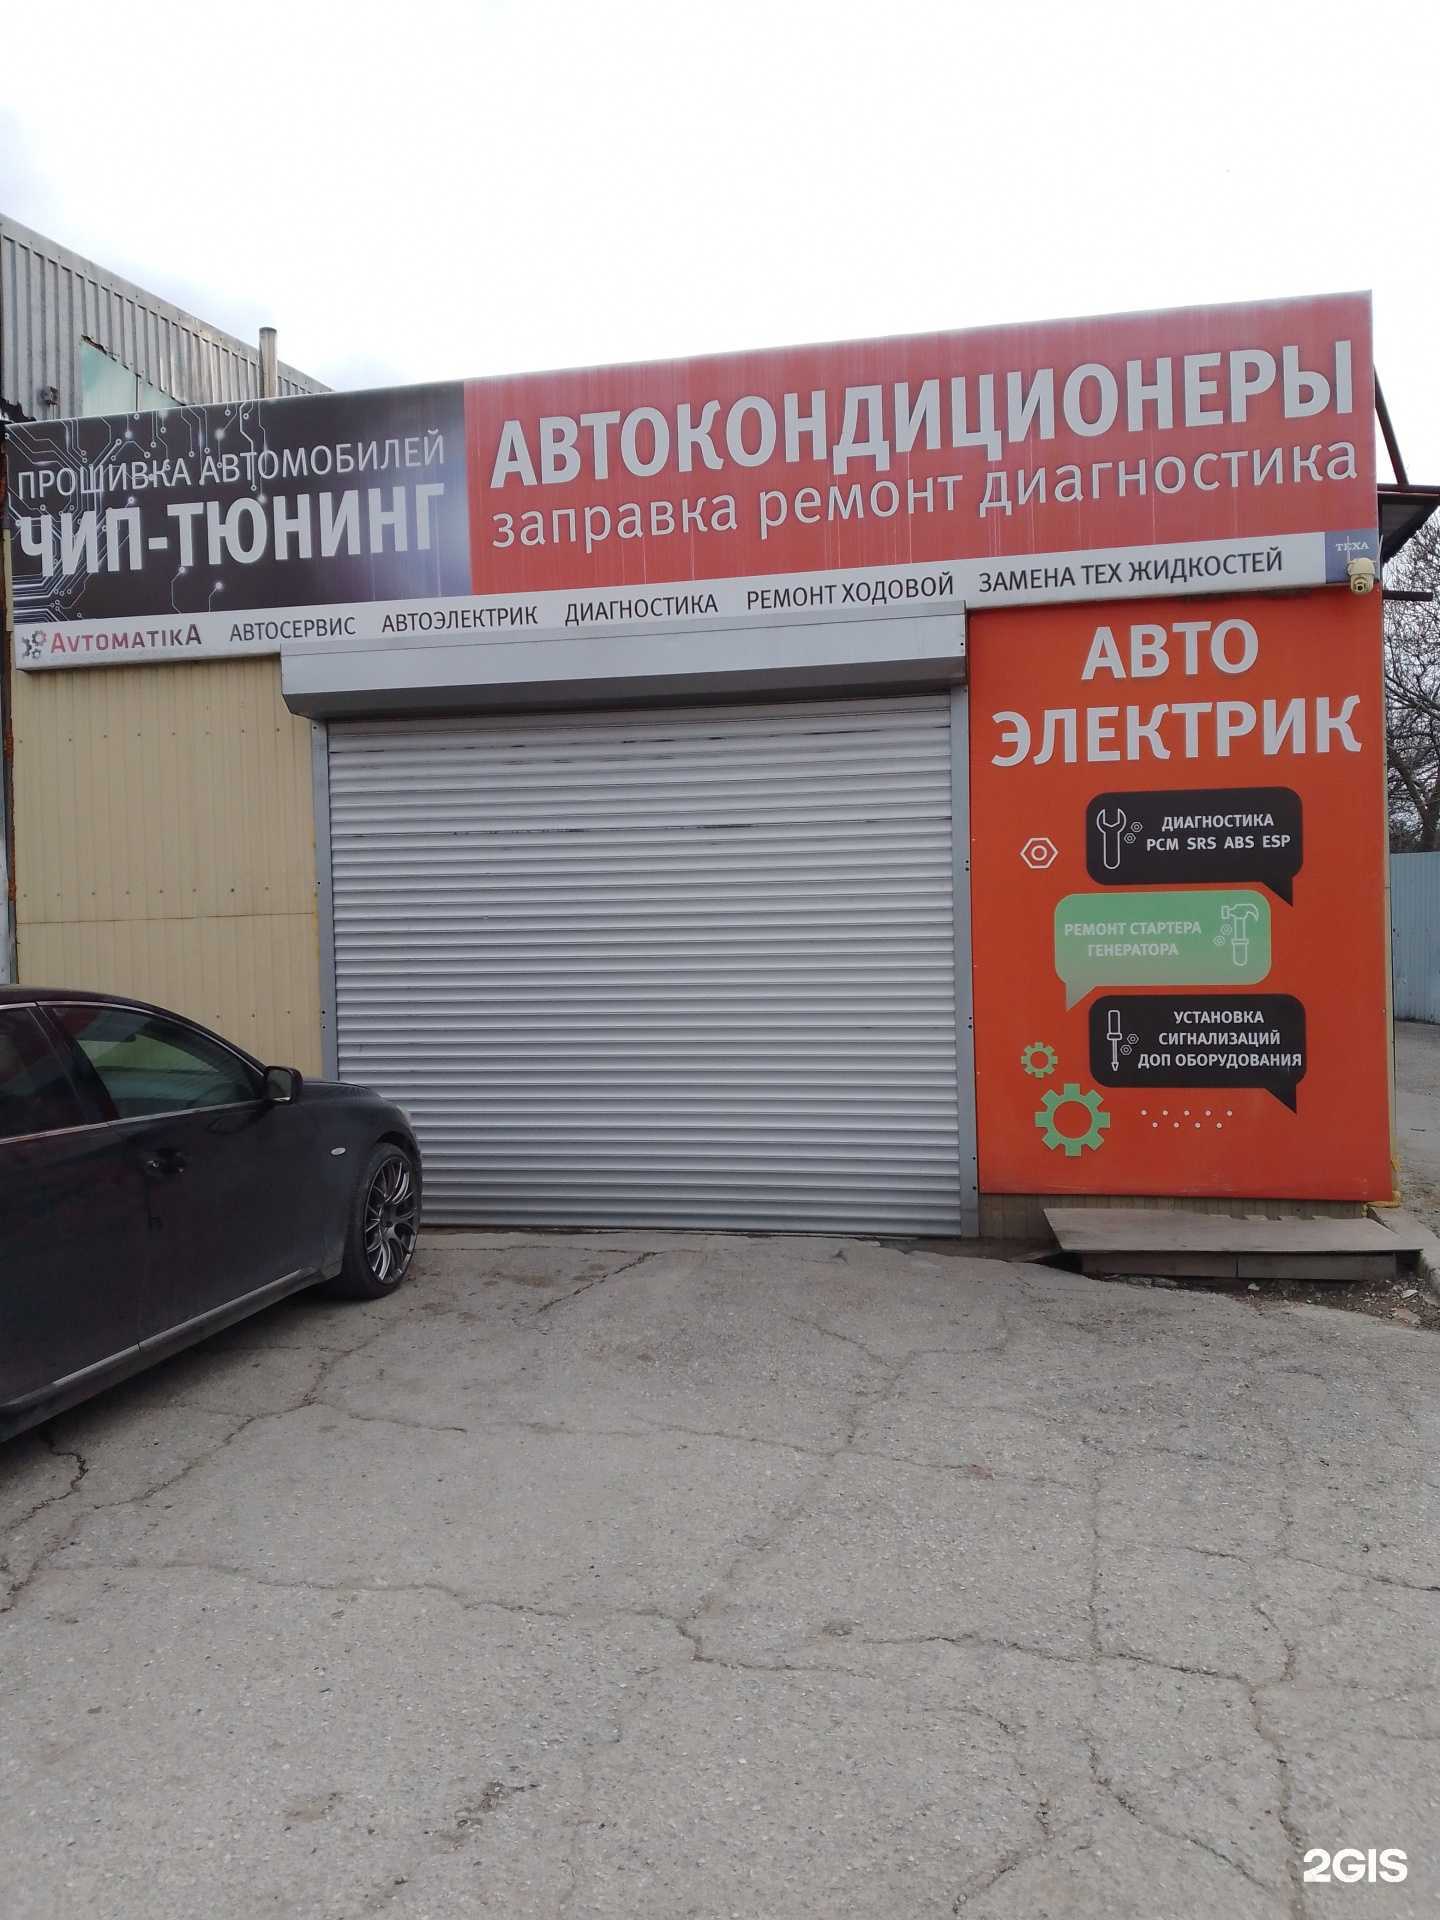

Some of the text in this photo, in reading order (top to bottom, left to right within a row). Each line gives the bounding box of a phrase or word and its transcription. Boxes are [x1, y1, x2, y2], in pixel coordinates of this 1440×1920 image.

[490, 340, 1353, 488] АВТОКОНДИЦИОНЕРЫ
[18, 429, 445, 499] ПРОШИВКА АВТОМОБИЛЕЙ
[492, 441, 1358, 554] заправка ремонт диагностика
[20, 483, 445, 577] ЧИП-ТЮНИНГ
[979, 547, 1283, 593] ЗАМЕНА ТЕХ ЖИДКОСТЕЙ
[747, 572, 954, 610] РЕМОНТ ХОДОВОЙ
[382, 606, 538, 633] АВТОЭЛЕКТРИК
[565, 594, 718, 626] ДИАГНОСТИКА
[230, 617, 356, 642] АВТОСЕРВИС
[1081, 618, 1259, 680] АВТО
[991, 695, 1362, 767] ЭЛЕКТРИК
[1162, 813, 1274, 832] ДИАГНОСТИКА
[1187, 836, 1217, 850] SRS
[1224, 835, 1255, 849] ABS
[1262, 834, 1291, 848] ESP
[1064, 920, 1202, 936] РЕМОНТ СТАРТЕРА
[1087, 943, 1179, 957] ГЕНЕРАТОРА
[1174, 1010, 1264, 1024] УСТАНОВКА
[1158, 1029, 1281, 1048] СИГНАЛИЗАЦИЙ
[1138, 1052, 1302, 1069] ДОП ОБОРУДОВАНИЯ
